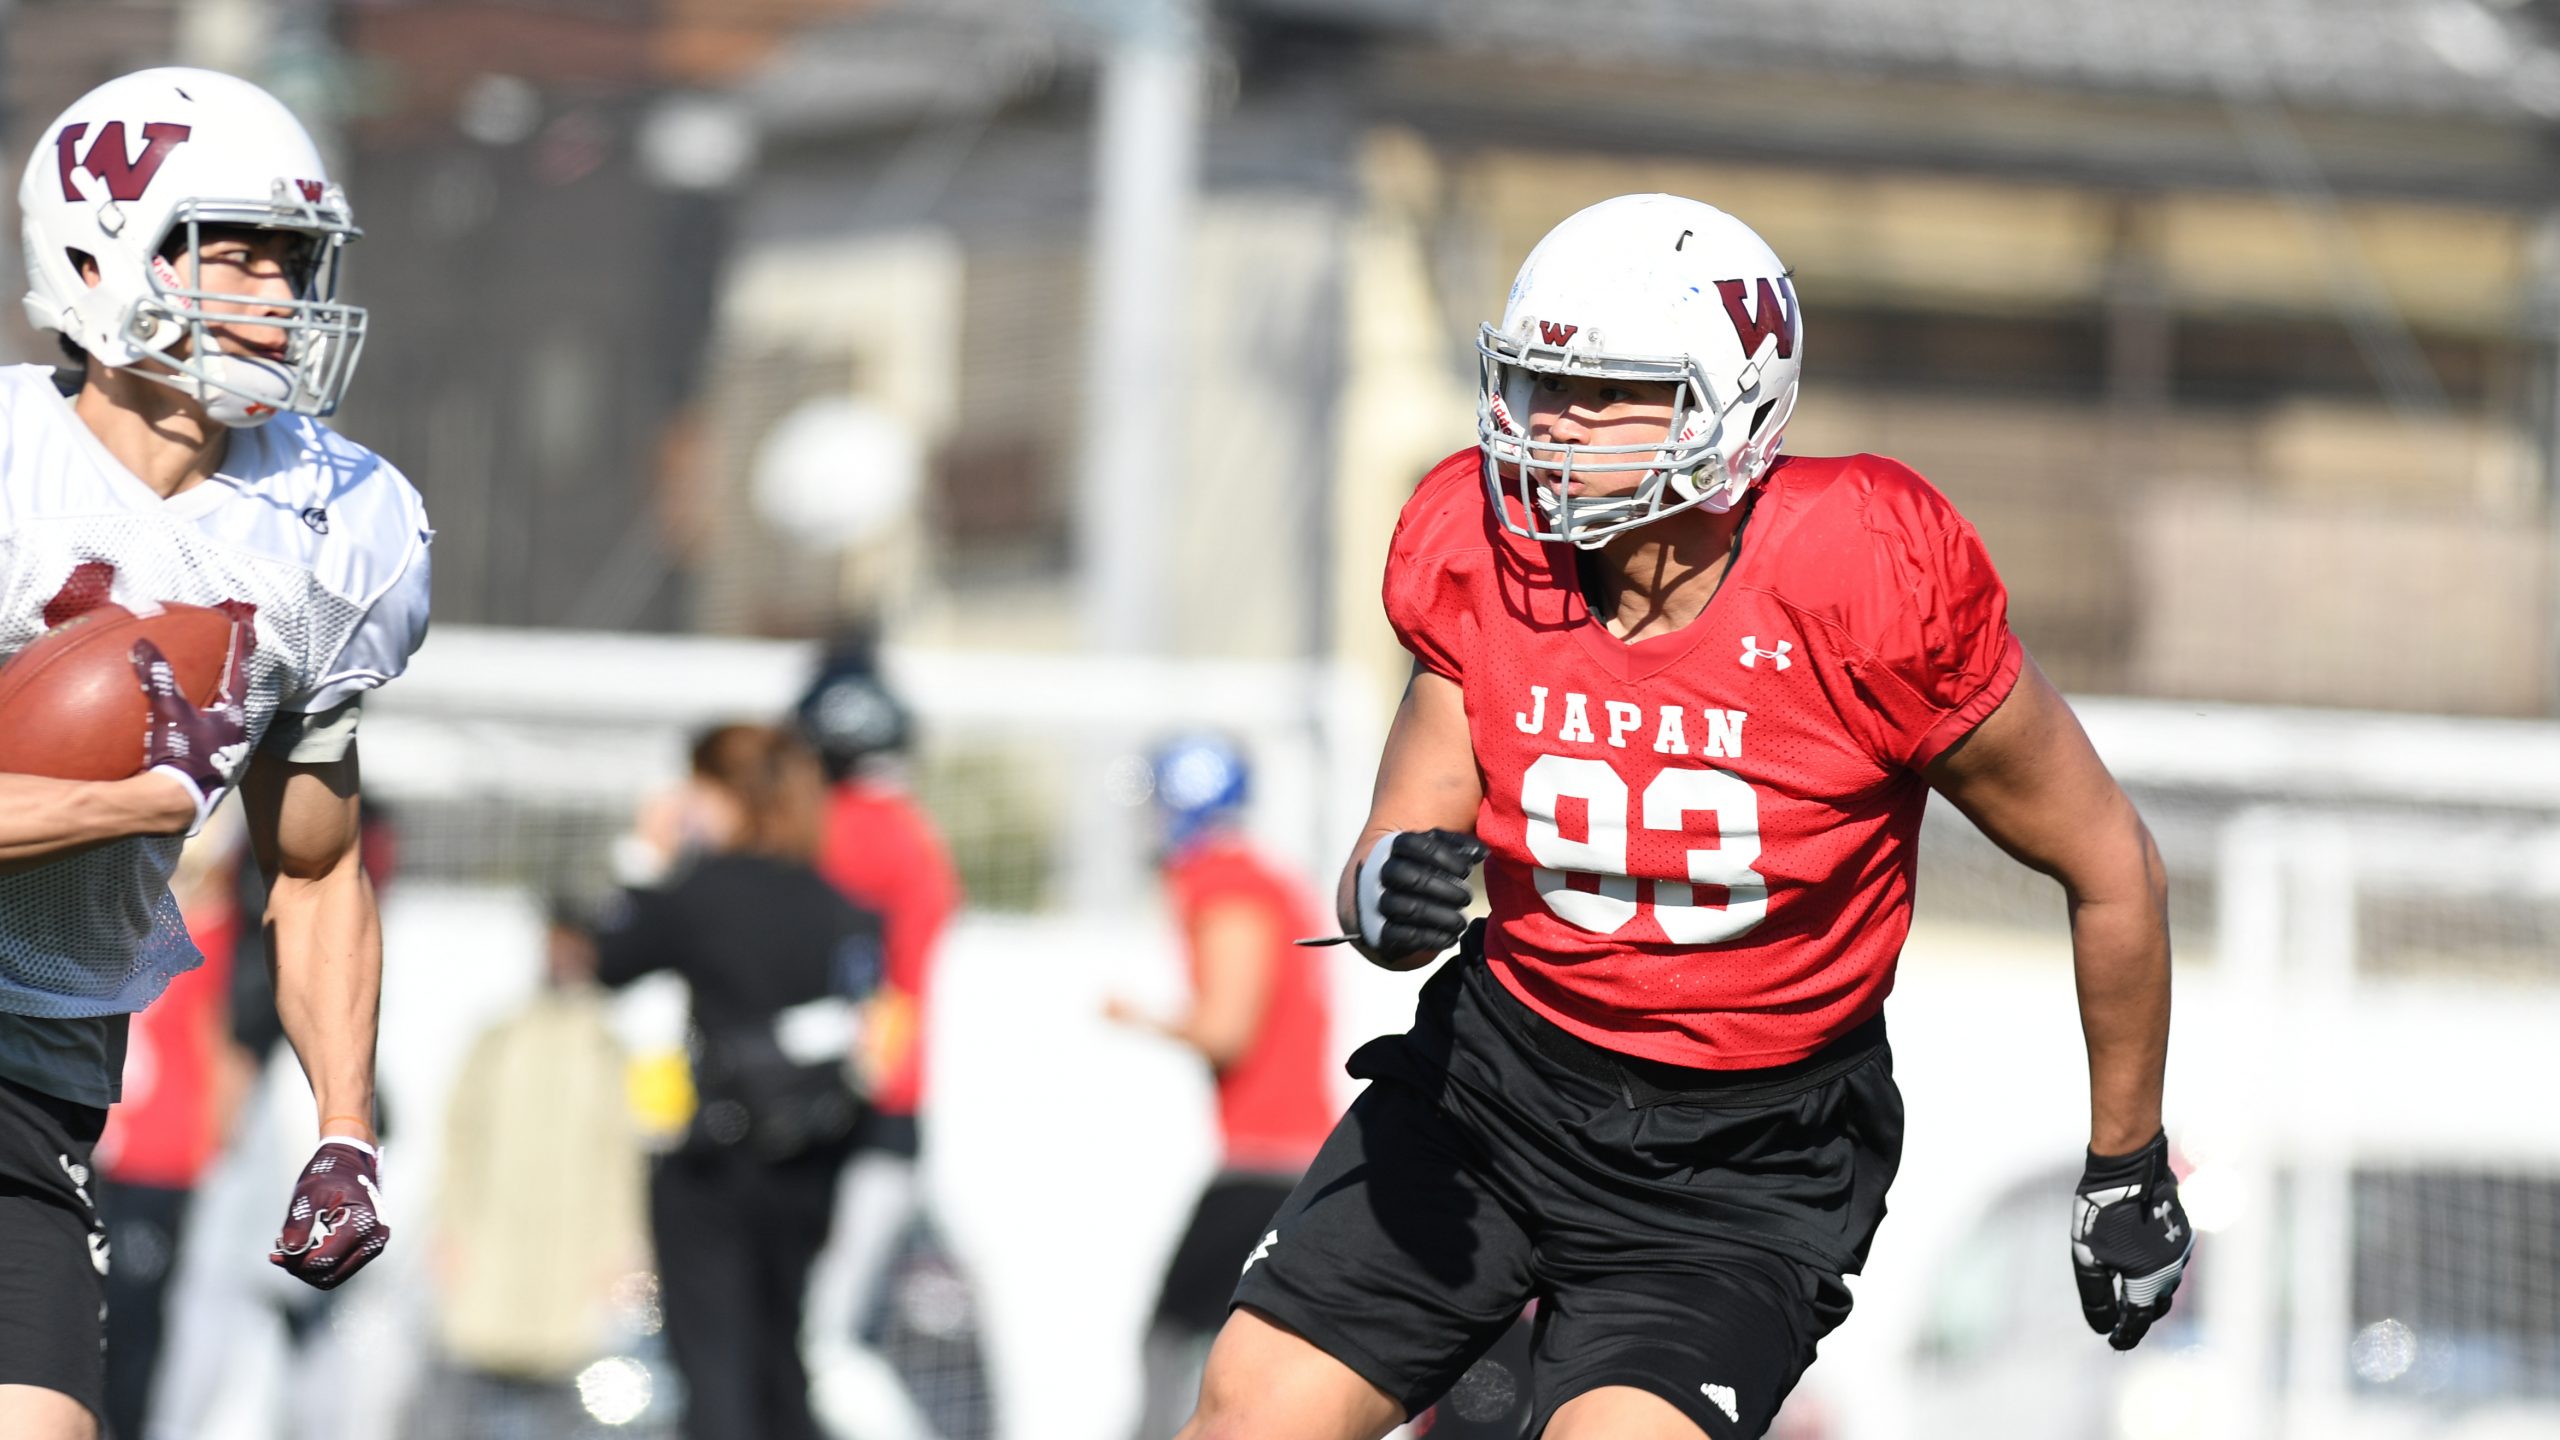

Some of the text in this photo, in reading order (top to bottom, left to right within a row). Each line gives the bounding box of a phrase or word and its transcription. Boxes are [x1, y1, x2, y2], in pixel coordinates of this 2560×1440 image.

[56, 121, 191, 202] W
[295, 179, 323, 204] W
[1539, 320, 1578, 347] W
[1712, 277, 1796, 360] W
[1516, 685, 1748, 758] JAPAN
[1521, 754, 1768, 944] 93
